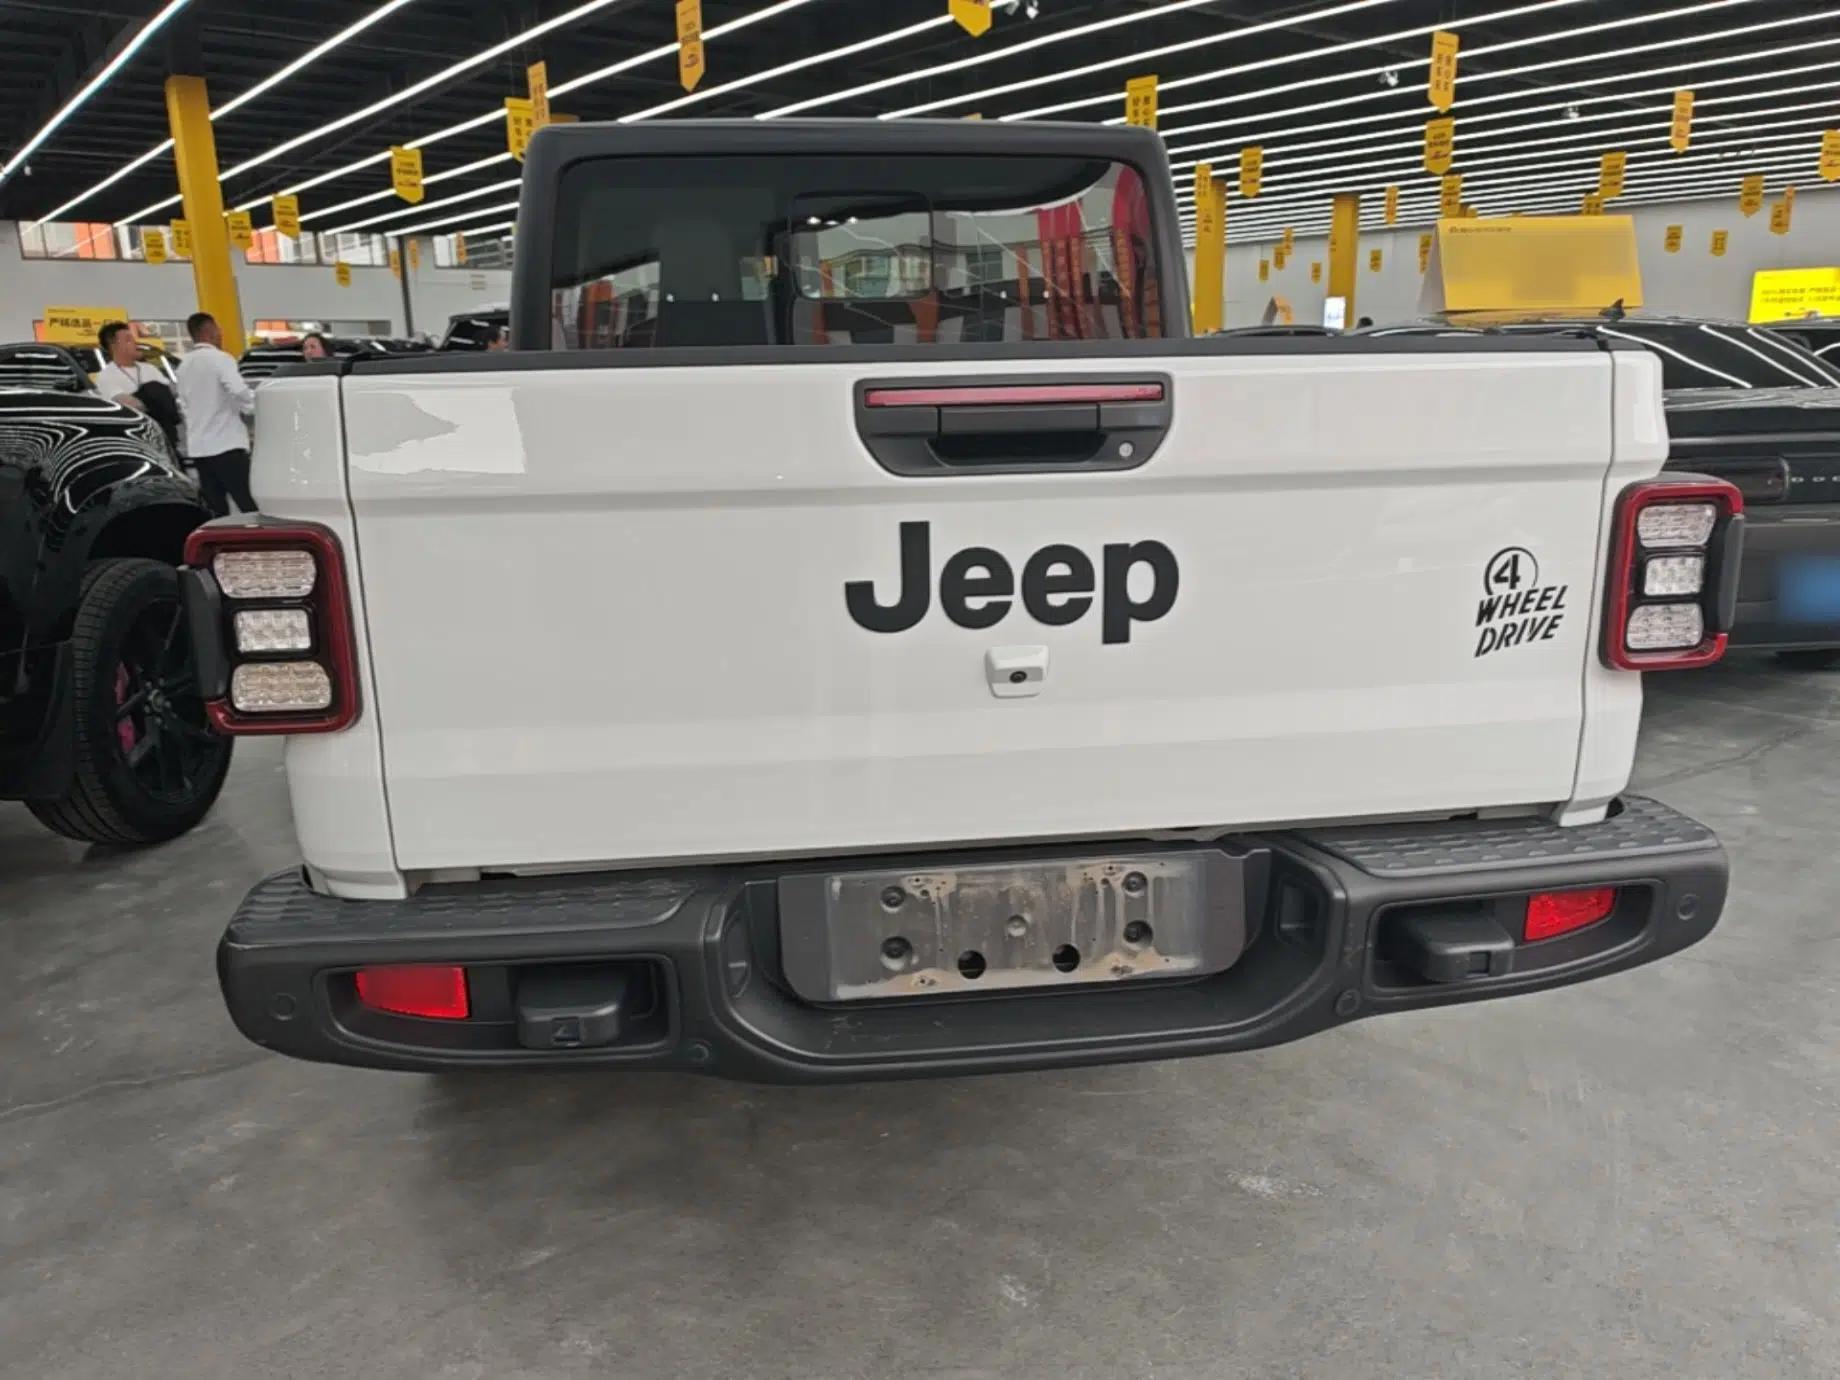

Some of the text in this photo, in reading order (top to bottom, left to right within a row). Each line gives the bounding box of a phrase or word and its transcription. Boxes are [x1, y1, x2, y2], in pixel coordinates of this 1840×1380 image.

[845, 521, 1179, 644] Jeep
[1493, 554, 1521, 589] 4
[1475, 585, 1568, 627] WHEEL
[1474, 614, 1564, 658] DRIVE
